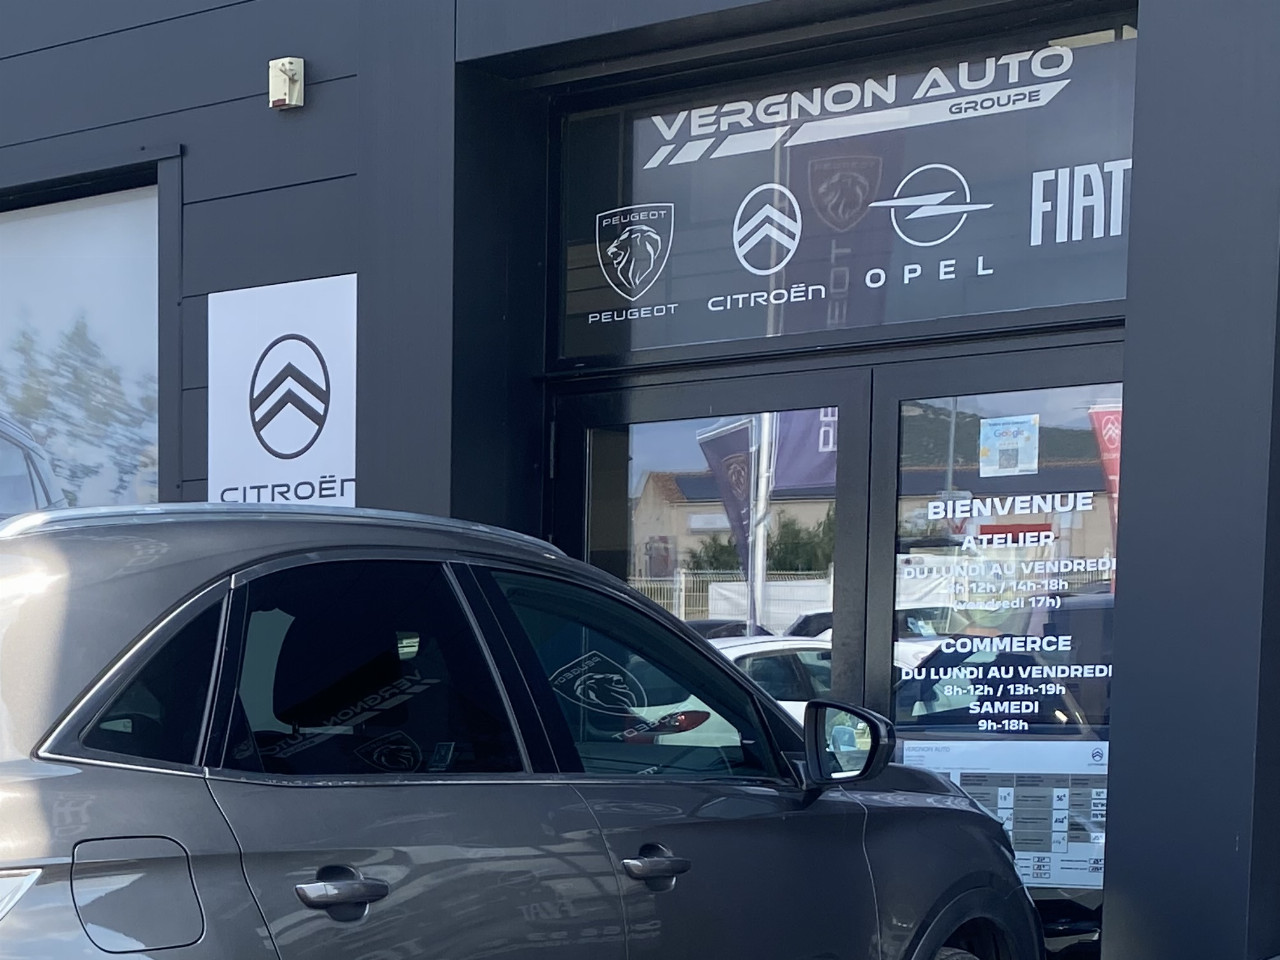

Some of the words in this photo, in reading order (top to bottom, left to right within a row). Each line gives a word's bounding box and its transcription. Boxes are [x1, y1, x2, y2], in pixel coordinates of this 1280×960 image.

[651, 74, 896, 140] VERGNON
[912, 46, 1074, 100] AUTO
[948, 89, 1041, 114] GROUPE
[1030, 158, 1132, 246] FIAT
[602, 210, 667, 227] PEUGEOT
[588, 303, 679, 324] PEUGEOT
[927, 491, 1095, 520] BIENVENUE
[961, 531, 1056, 552] ATELIER
[903, 567, 931, 580] DU
[1021, 558, 1117, 574] VENDREDI
[1010, 579, 1069, 592] 14h-18h
[1029, 595, 1062, 609] 17h)
[940, 635, 1073, 654] COMMERCE
[901, 669, 926, 681] DU
[930, 667, 983, 680] LUNDI
[986, 666, 1014, 680] AU
[1017, 664, 1113, 679] VENDREDI
[943, 685, 994, 697] 8h-12h
[1007, 684, 1066, 696] 13h-19h
[969, 701, 1039, 714] SAMEDI
[978, 720, 1029, 732] 9h-18h
